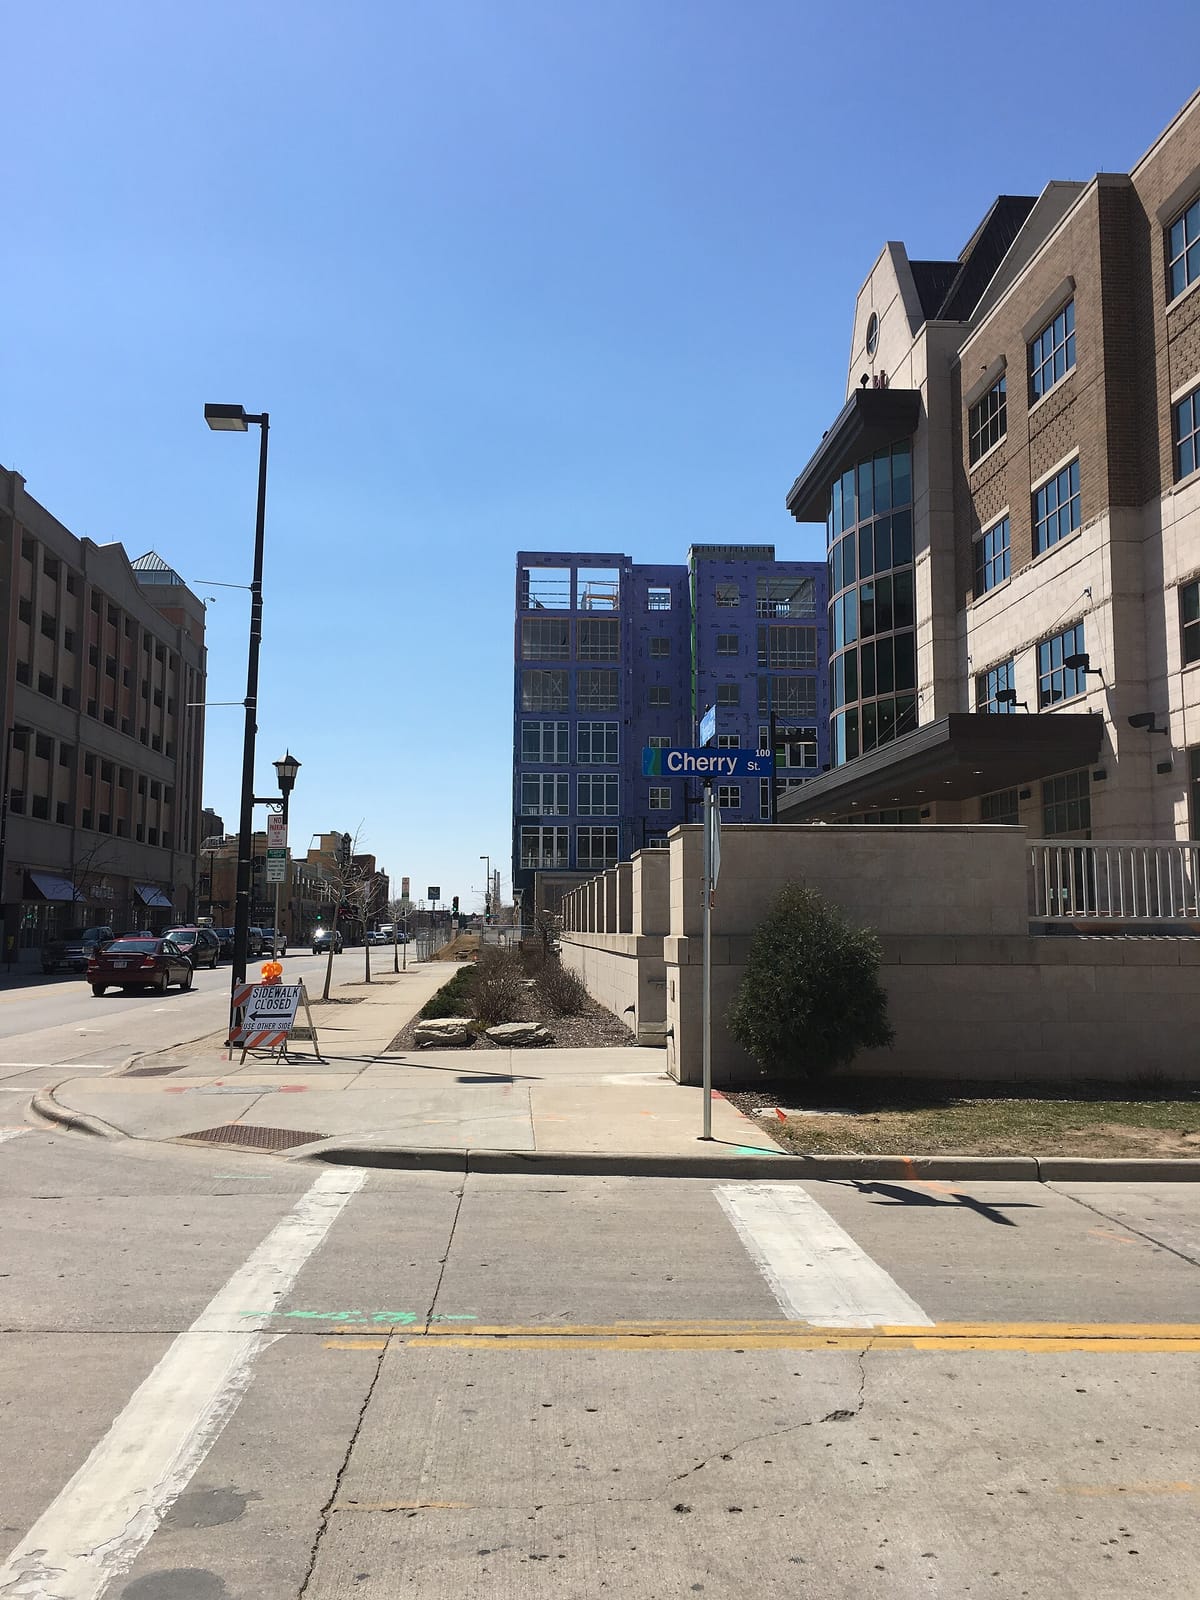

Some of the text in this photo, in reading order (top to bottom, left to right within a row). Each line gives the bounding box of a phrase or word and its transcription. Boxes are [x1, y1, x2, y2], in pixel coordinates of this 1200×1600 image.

[755, 749, 770, 757] 100
[667, 751, 761, 775] Cherry St.
[253, 987, 298, 998] SIDEWALK
[255, 999, 291, 1010] CLOSED
[243, 1022, 291, 1030] USE OTHER SIDE
